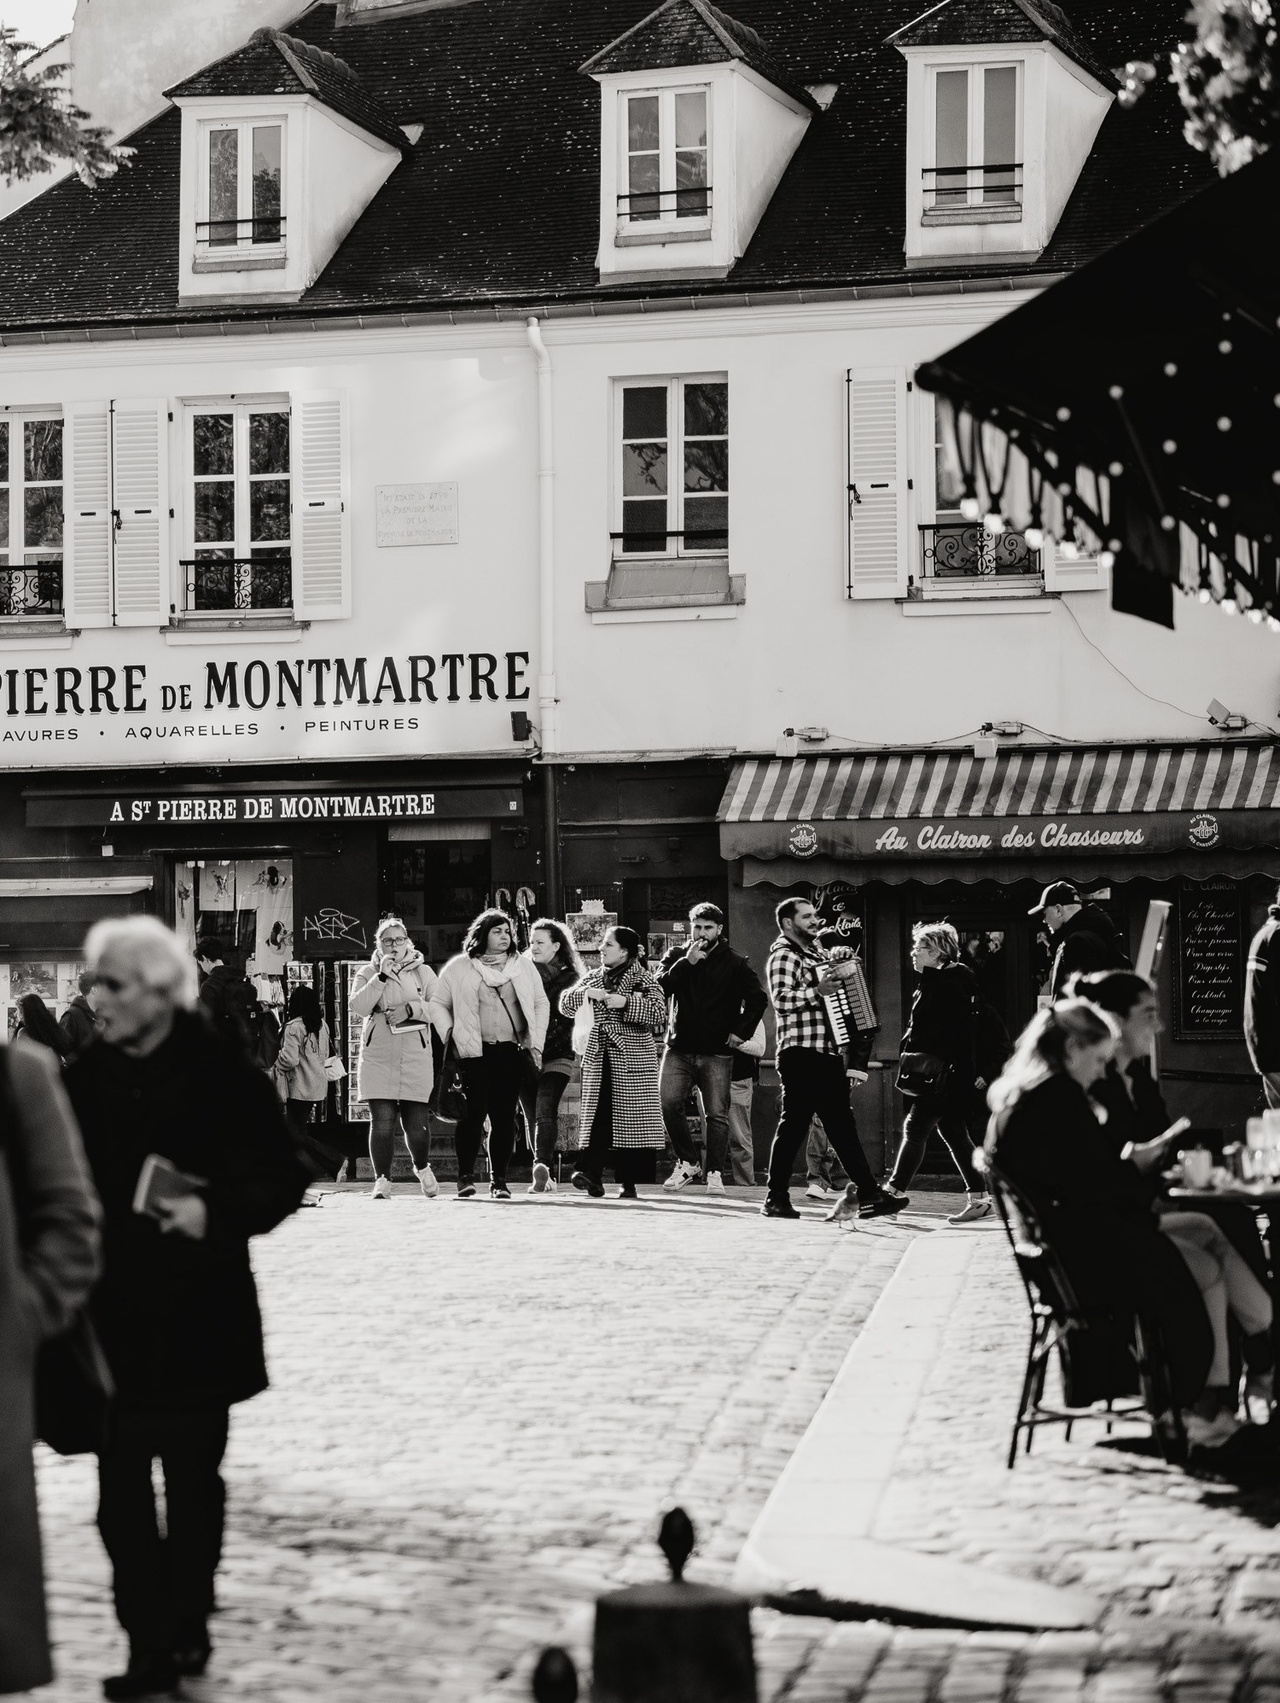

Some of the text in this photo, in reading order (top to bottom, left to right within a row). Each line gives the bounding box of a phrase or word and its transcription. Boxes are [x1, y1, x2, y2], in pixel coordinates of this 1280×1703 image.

[161, 685, 193, 711] DE
[204, 651, 531, 709] MONTMARTRE
[125, 723, 259, 739] AQUARELLES
[305, 717, 419, 732] PEINTURES
[110, 806, 124, 822] A
[157, 798, 237, 821] PIERRE
[243, 796, 273, 819] DE
[279, 794, 435, 818] MONTMARTRE
[875, 823, 1145, 850] Au Clairon des Chasseurs
